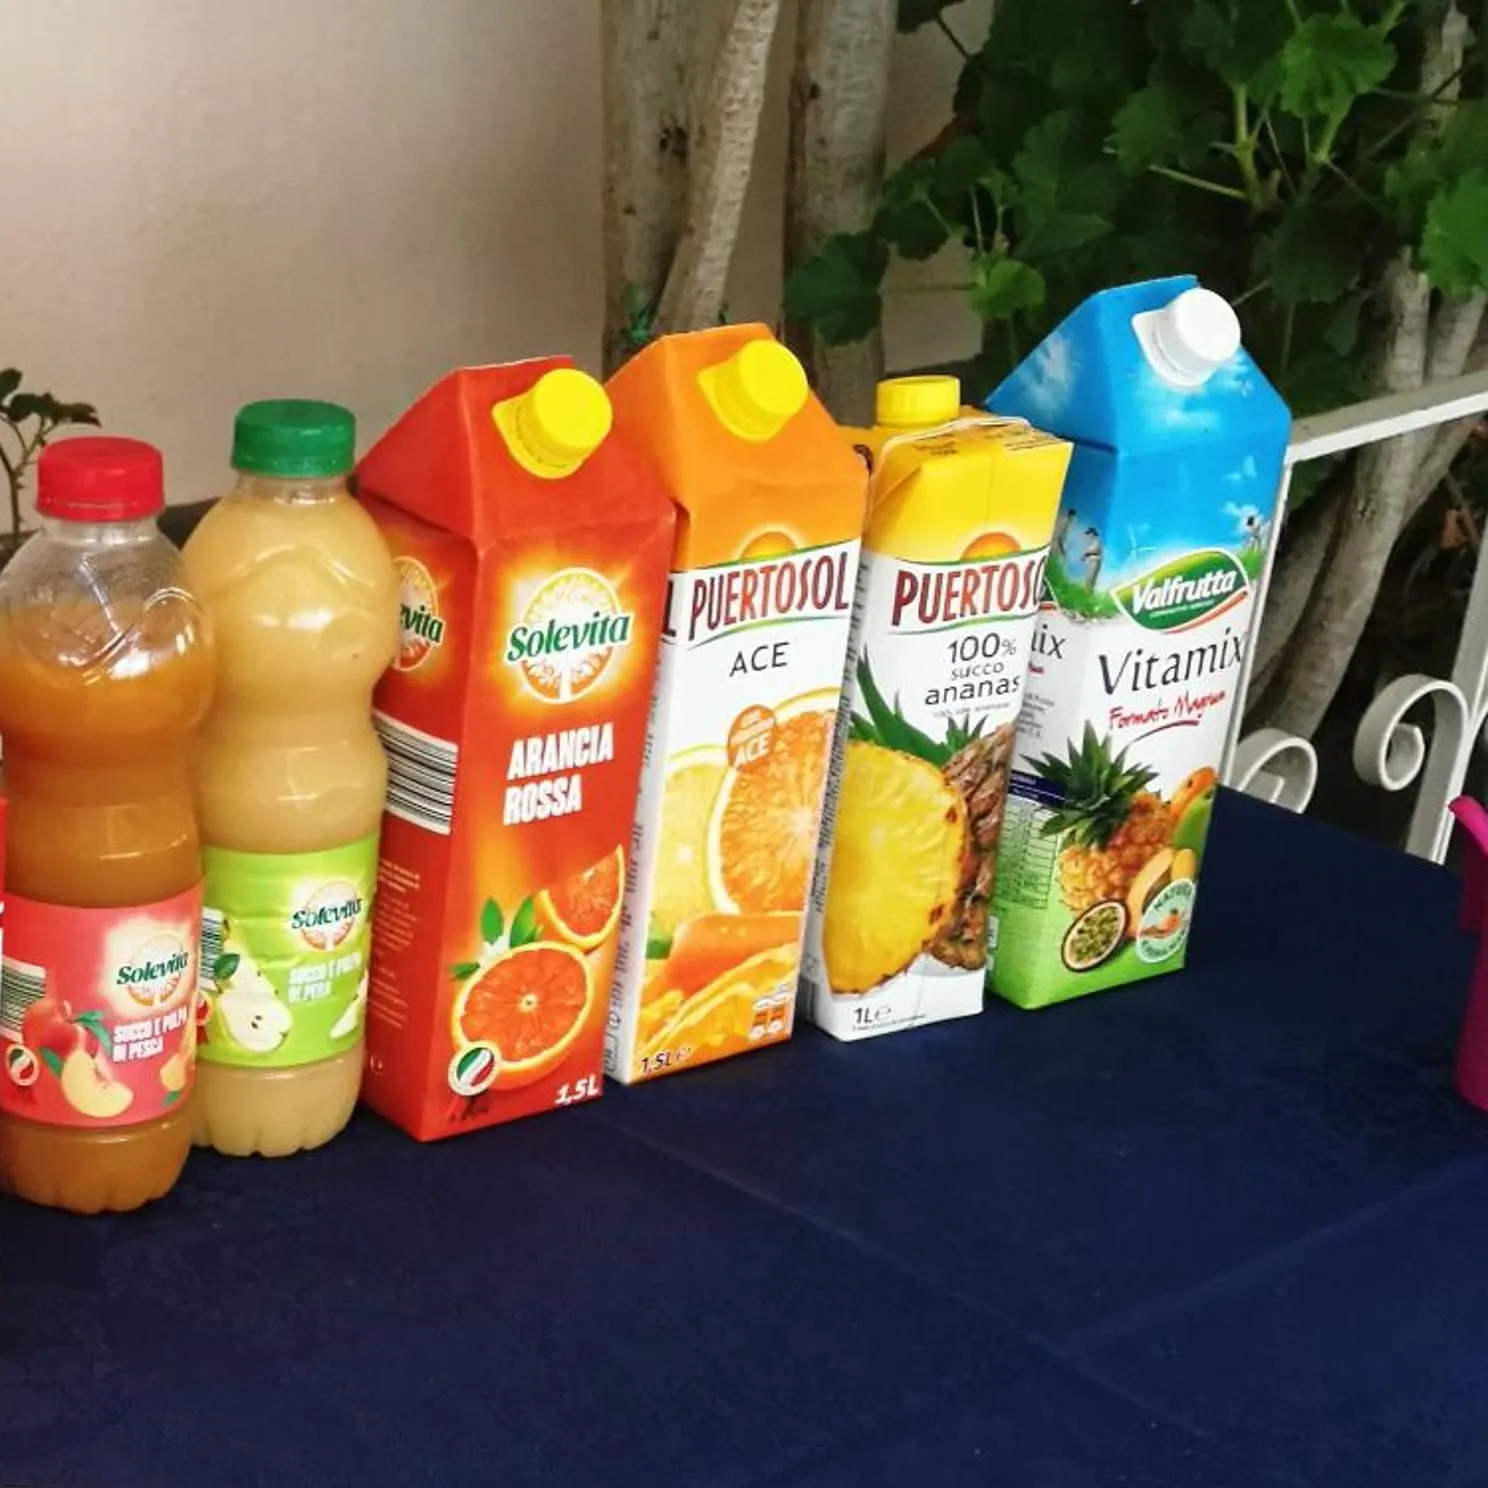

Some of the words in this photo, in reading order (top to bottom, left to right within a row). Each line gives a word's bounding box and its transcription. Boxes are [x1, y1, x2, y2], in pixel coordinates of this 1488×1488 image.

[688, 551, 849, 641] PUERTOSOL
[1132, 569, 1237, 615] Valfrutta
[508, 611, 631, 662] Solevita
[948, 632, 1016, 663] 100%
[730, 641, 790, 677] ACE
[952, 662, 1004, 680] succo
[1098, 626, 1241, 695] Vitamix
[925, 675, 1020, 705] ananas
[507, 722, 614, 780] ARANCIA
[503, 774, 582, 825] ROSSA
[291, 898, 364, 929] Solevita
[117, 952, 188, 984] Solevita
[555, 1074, 600, 1106] 1,5L
